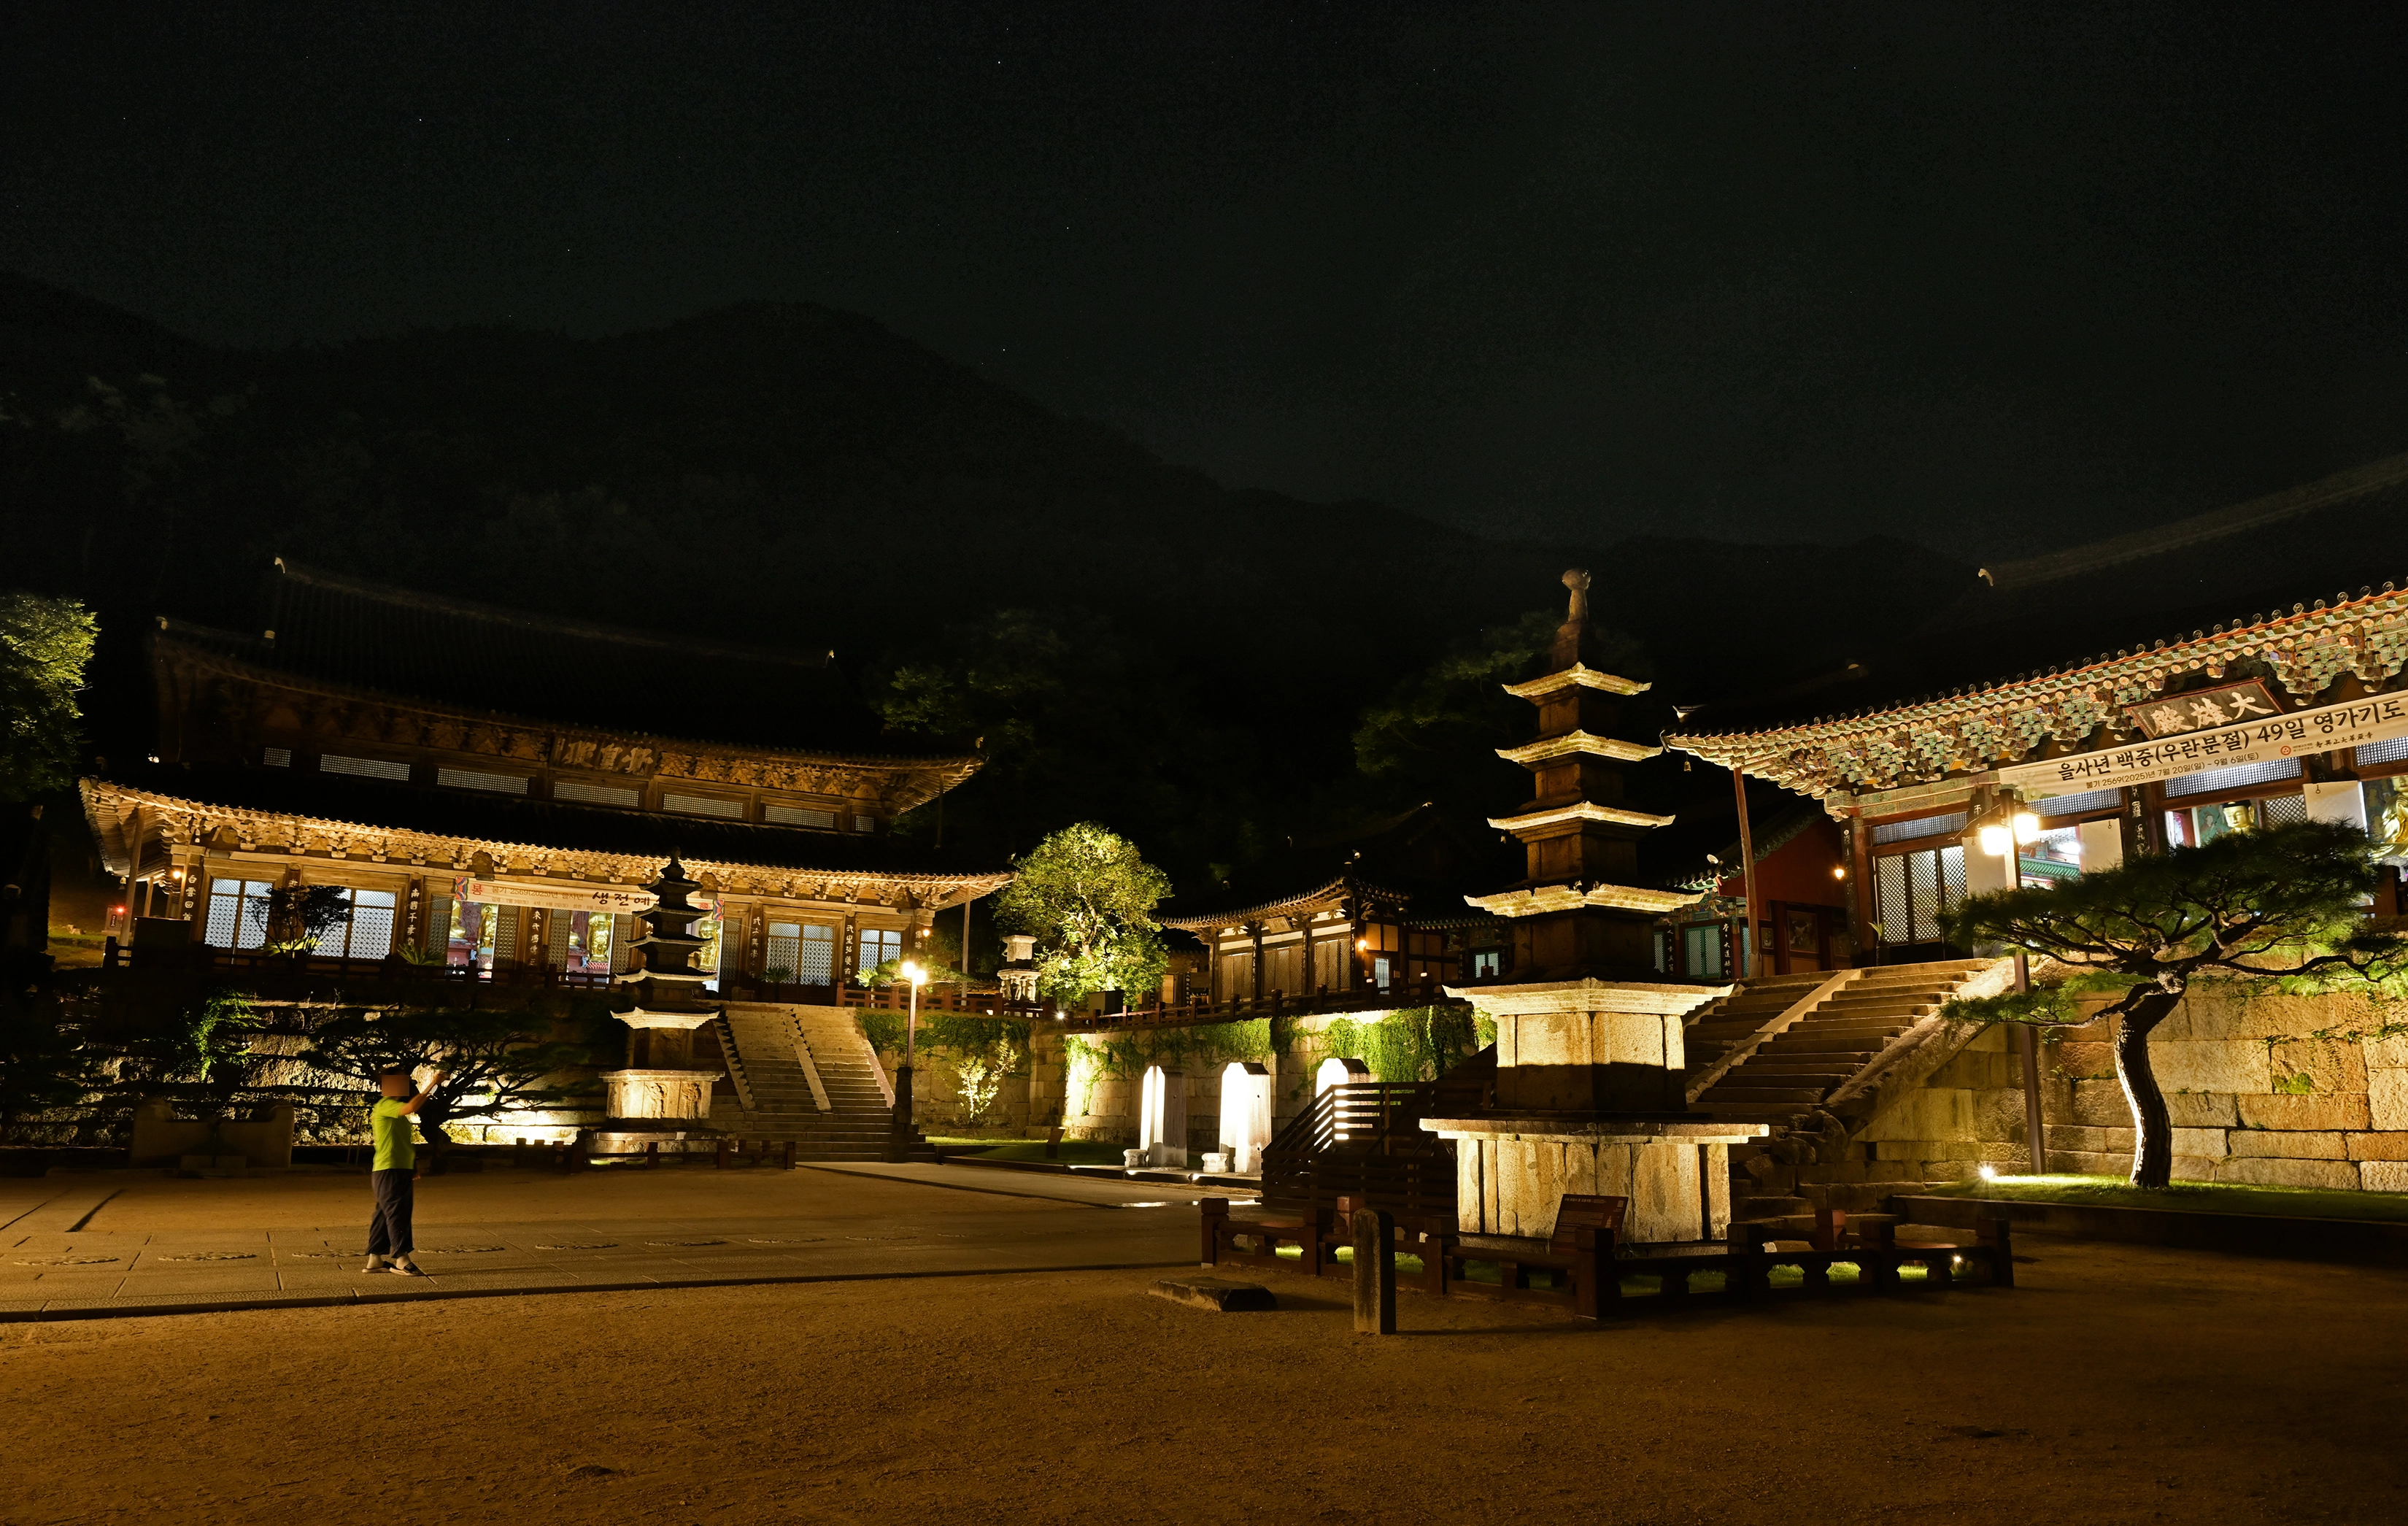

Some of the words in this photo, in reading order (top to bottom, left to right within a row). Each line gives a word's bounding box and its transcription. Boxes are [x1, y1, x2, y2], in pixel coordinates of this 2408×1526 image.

[2058, 755, 2111, 782] 을사년
[2116, 729, 2250, 768] 백중(우란분절)
[2257, 718, 2307, 743] 49일
[2313, 700, 2407, 734] 영가기도
[2085, 781, 2101, 789] 불기
[2102, 770, 2156, 787] 2569(2025)년
[2158, 767, 2170, 777] 7월
[2173, 761, 2206, 775] 20일(일)
[2214, 758, 2228, 767] 9월
[2230, 752, 2260, 764] 6일(토)
[472, 884, 482, 895] 봉
